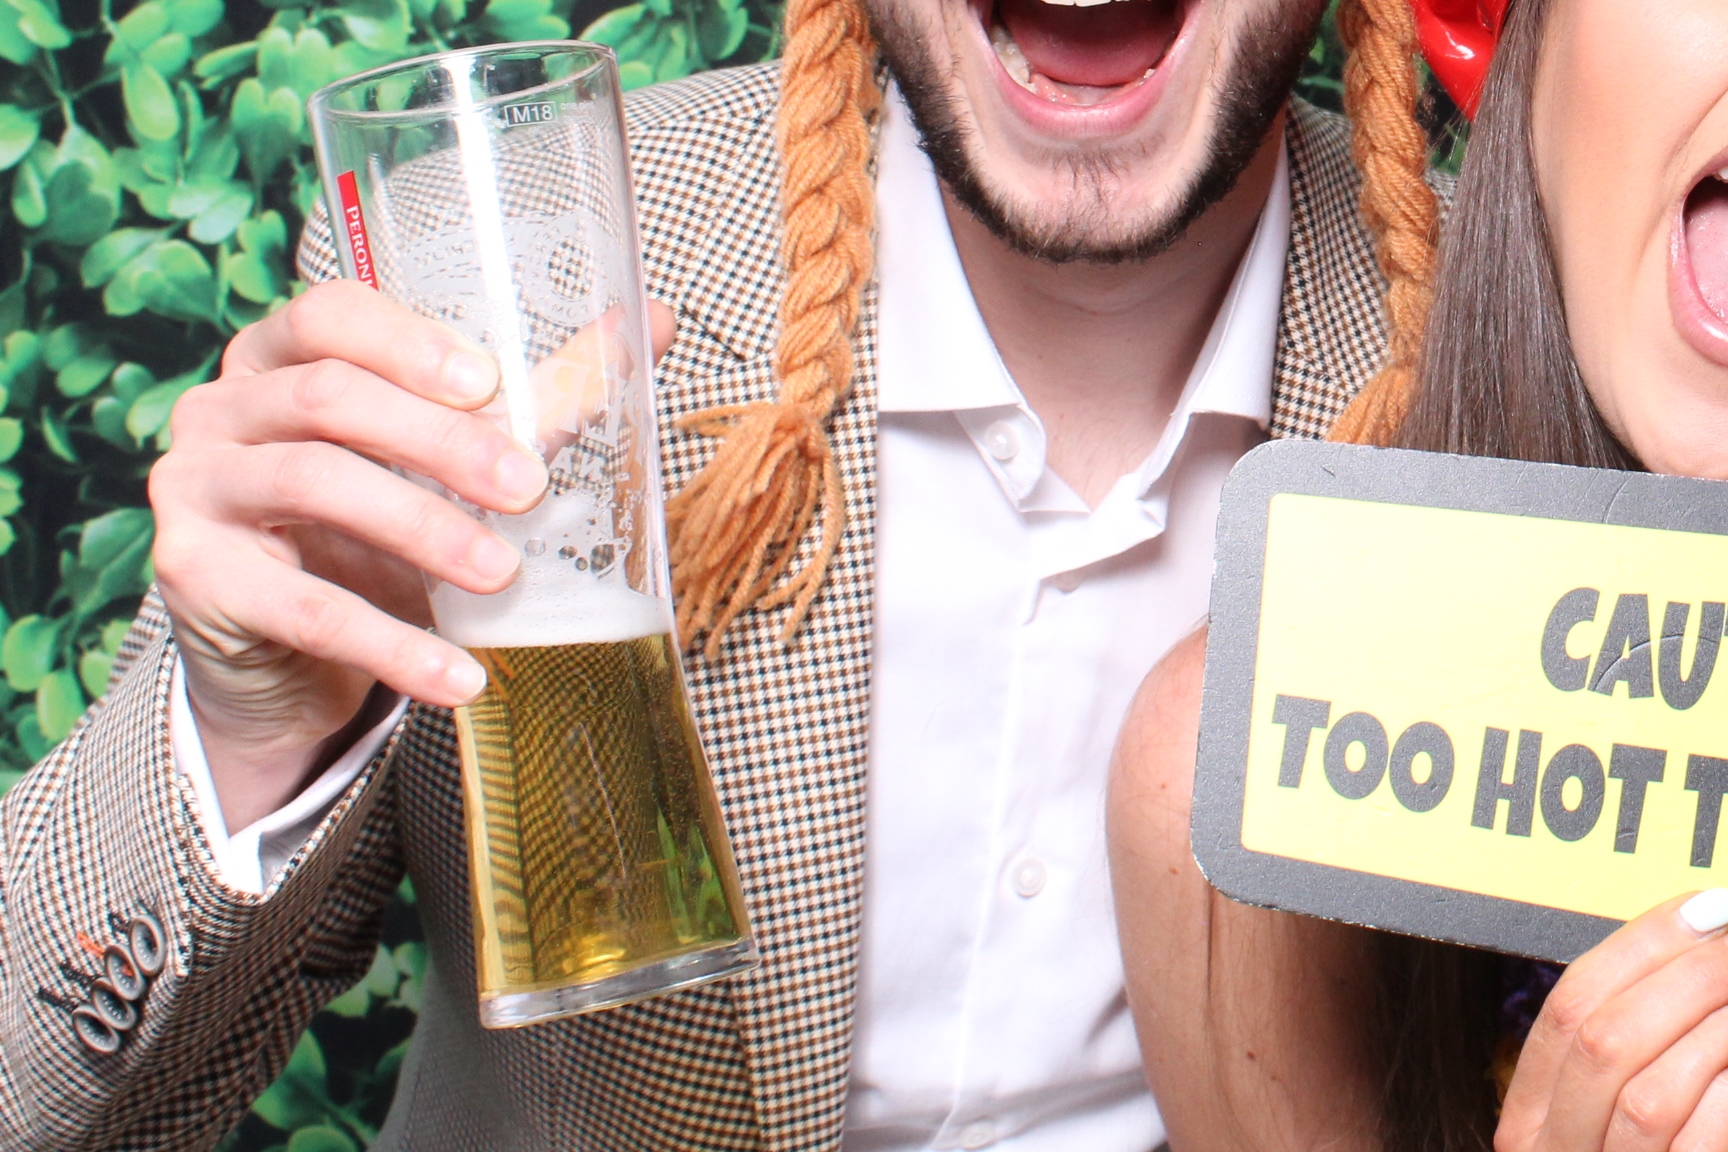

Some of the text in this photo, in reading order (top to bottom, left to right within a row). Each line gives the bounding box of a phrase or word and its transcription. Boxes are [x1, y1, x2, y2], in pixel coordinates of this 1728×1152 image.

[512, 105, 553, 123] M18
[1271, 693, 1456, 814] TOO
[1471, 727, 1667, 855] HOT
